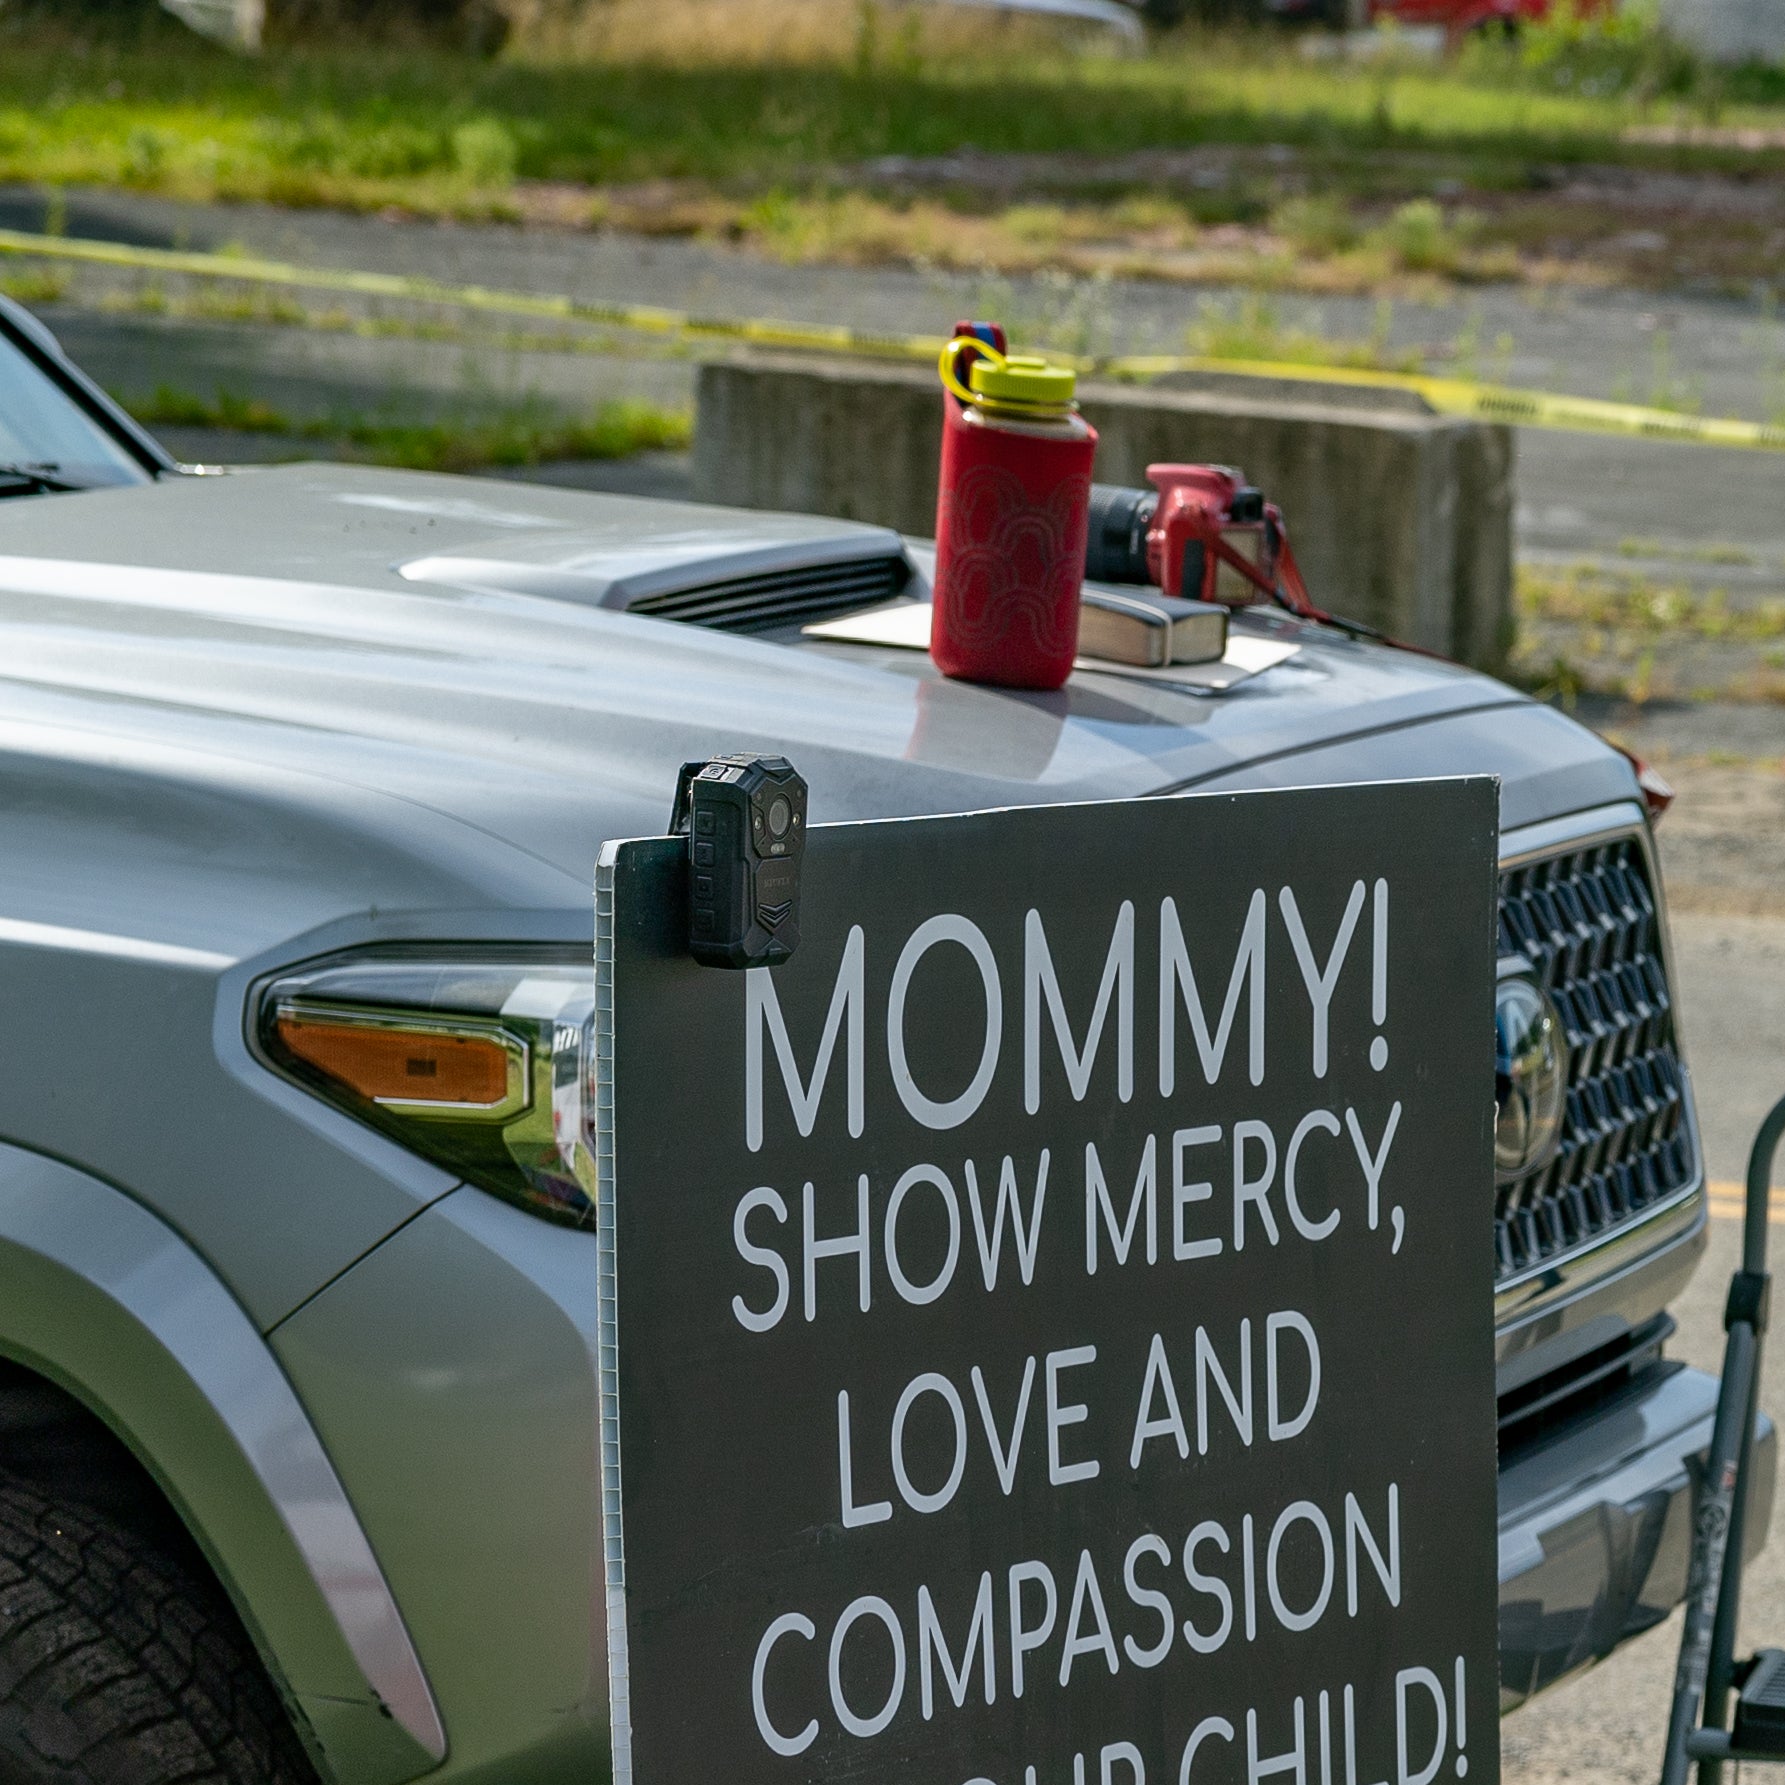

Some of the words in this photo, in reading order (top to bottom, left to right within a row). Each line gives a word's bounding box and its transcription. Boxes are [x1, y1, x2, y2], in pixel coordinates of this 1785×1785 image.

[744, 876, 1390, 1154] MOMMY!
[731, 1147, 1052, 1333] SHOW
[1085, 1099, 1405, 1277] MERCY,
[837, 1344, 1101, 1529] LOVE
[1129, 1309, 1322, 1470] AND
[751, 1482, 1402, 1757] COMPASSION
